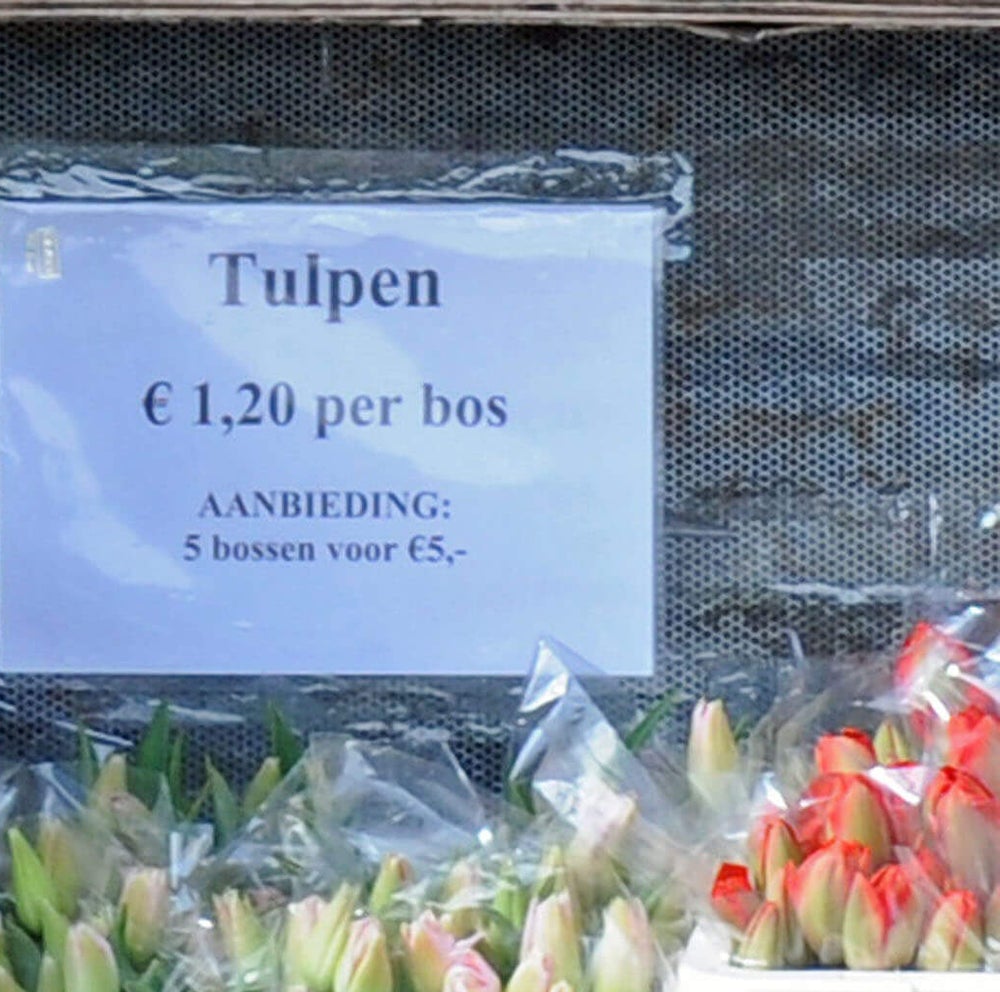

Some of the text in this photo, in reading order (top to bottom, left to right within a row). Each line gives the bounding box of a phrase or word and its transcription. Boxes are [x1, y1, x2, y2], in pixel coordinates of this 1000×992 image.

[208, 252, 442, 324] Tulpen
[142, 380, 509, 440] € 1,20 per bos
[199, 490, 451, 519] AANBIEDING:
[183, 533, 468, 565] 5 bossen voor €5,-
